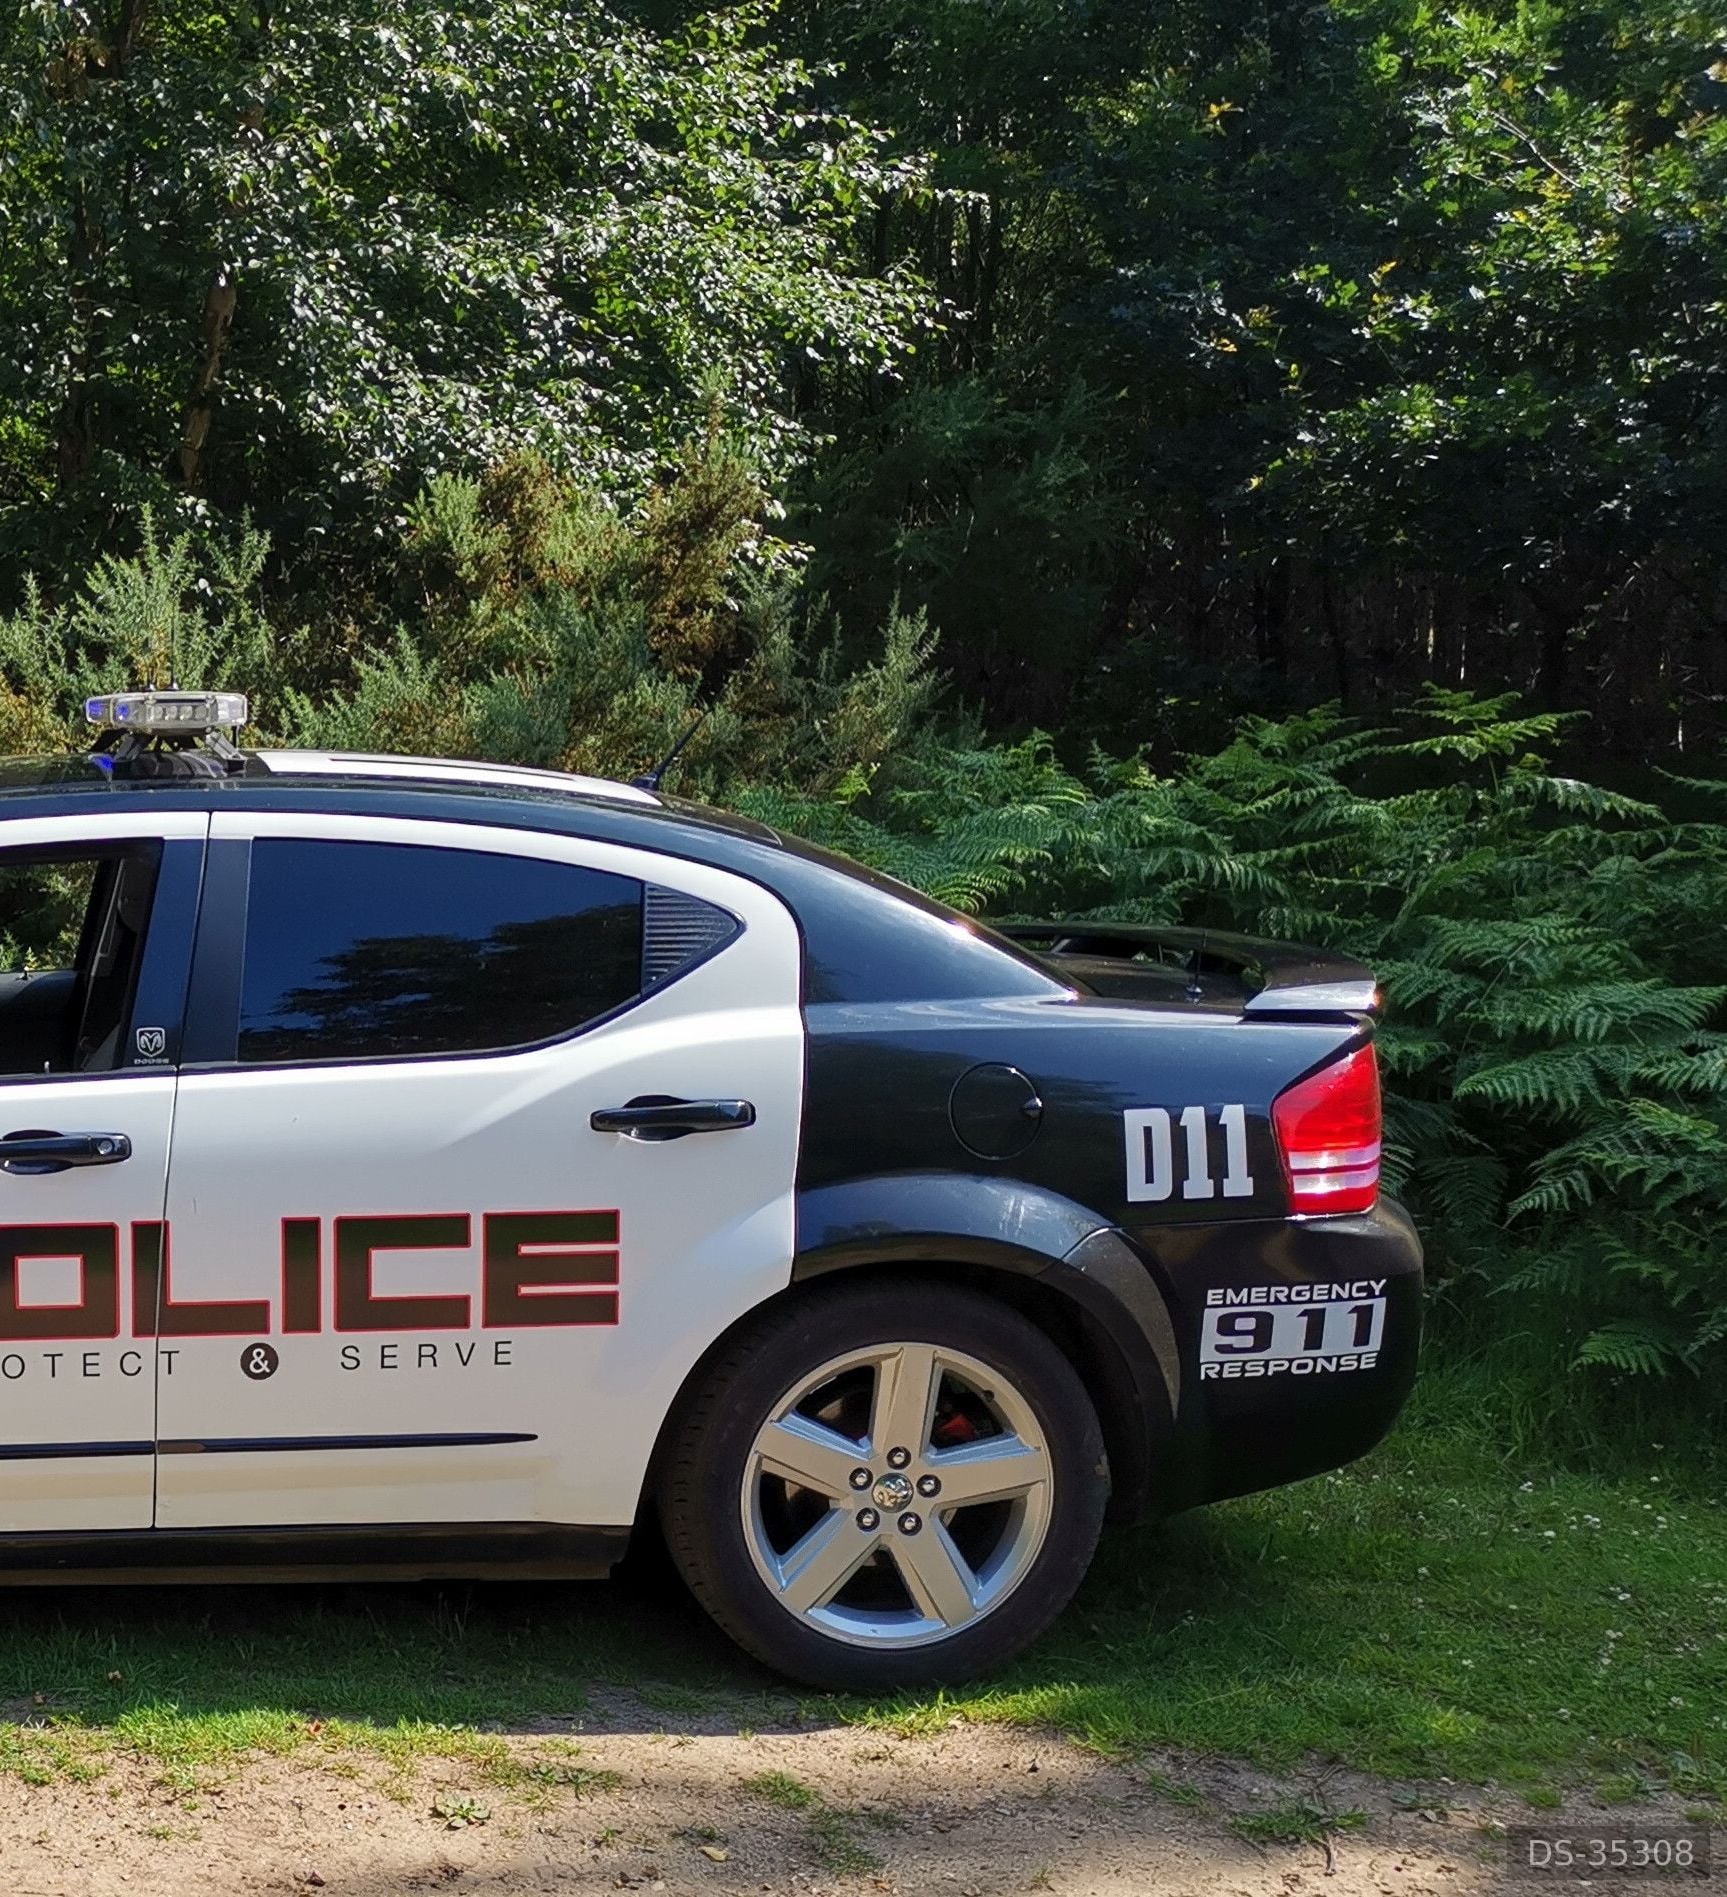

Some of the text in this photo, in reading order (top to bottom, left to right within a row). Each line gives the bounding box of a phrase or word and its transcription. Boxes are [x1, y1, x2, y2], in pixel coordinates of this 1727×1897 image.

[1124, 1104, 1254, 1202] D11
[1206, 1279, 1387, 1306] EMERGENCY
[1213, 1303, 1375, 1355] 911
[247, 1346, 273, 1376] &
[339, 1340, 513, 1371] SERVE
[1200, 1352, 1378, 1381] RESPONSE
